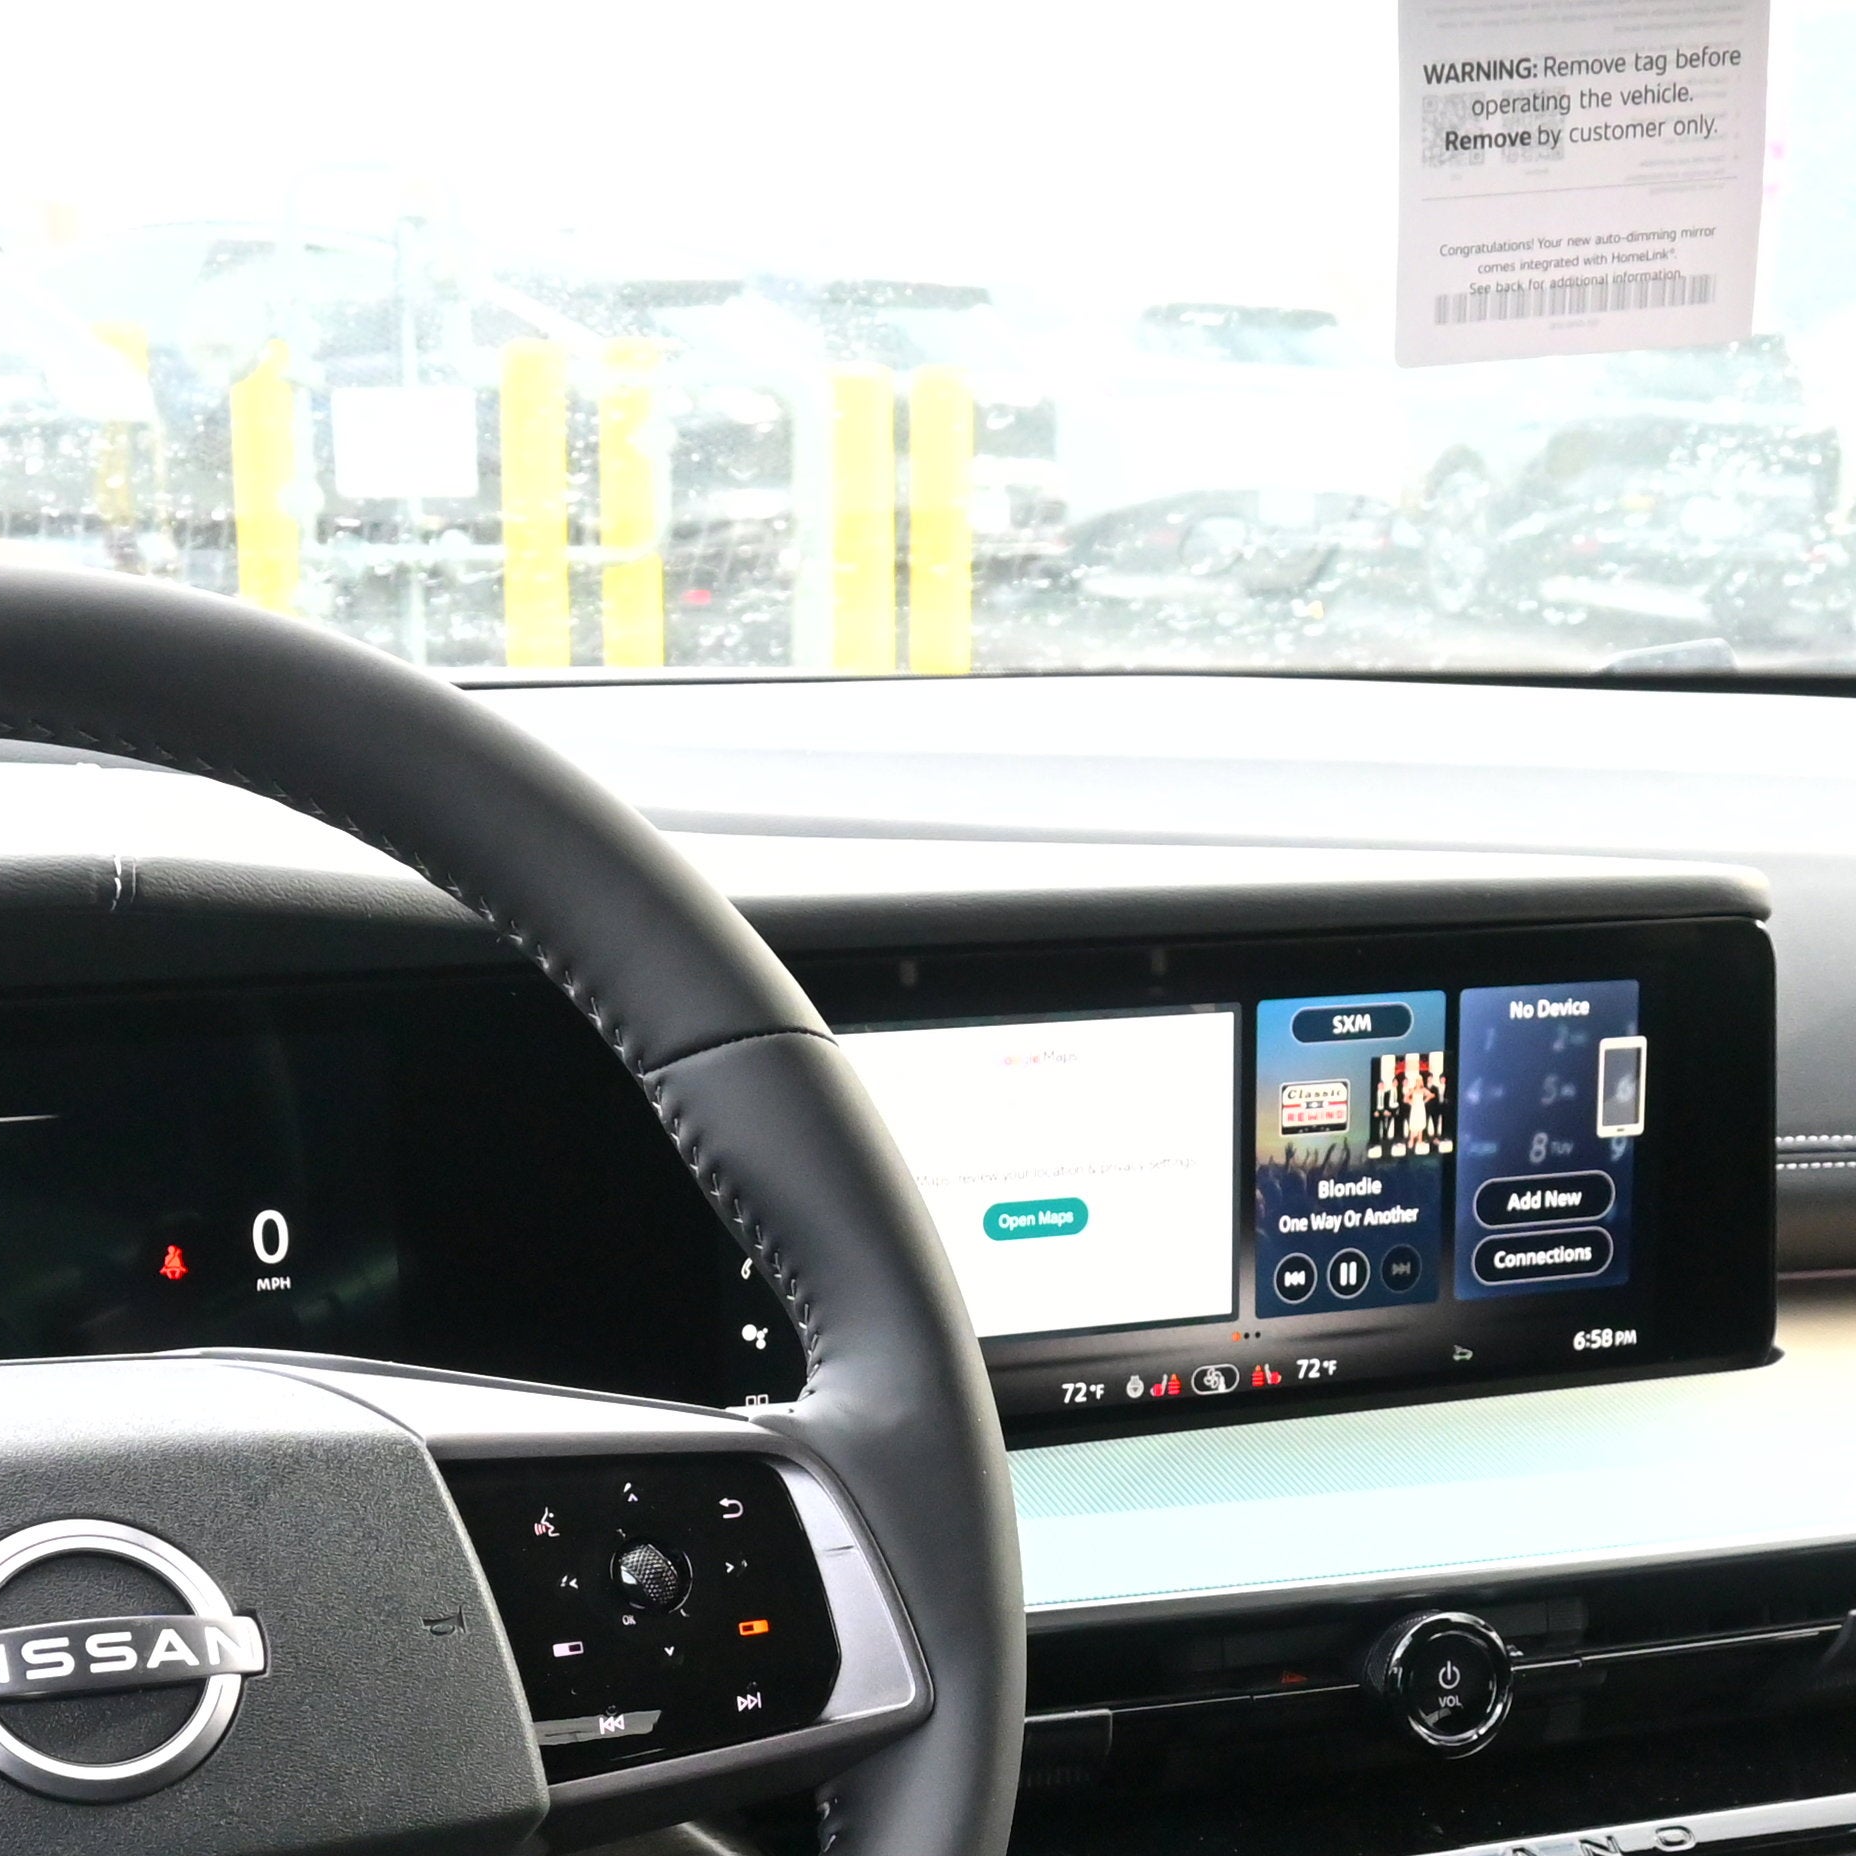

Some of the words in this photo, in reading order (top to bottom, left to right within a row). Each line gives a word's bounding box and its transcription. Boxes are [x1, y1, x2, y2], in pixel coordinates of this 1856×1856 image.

[1423, 56, 1538, 85] WARNING:
[1544, 53, 1626, 78] Remove
[1634, 51, 1667, 76] tag
[1676, 46, 1742, 70] before
[1471, 90, 1571, 120] operating
[1580, 88, 1612, 110] the
[1620, 83, 1693, 107] vehicle.
[1444, 130, 1532, 151] Remove
[1538, 124, 1561, 149] by
[1569, 118, 1665, 144] customer
[1673, 114, 1718, 140] only.
[1439, 238, 1535, 259] Congratulations!
[1538, 234, 1563, 249] Your
[1567, 235, 1591, 247] new
[1594, 227, 1677, 247] auto-dimming
[1681, 225, 1716, 240] mirror
[1477, 262, 1515, 274] comes
[1519, 253, 1580, 273] integrated
[1583, 252, 1608, 267] with
[1469, 282, 1491, 295] See
[1495, 279, 1524, 295] back
[1528, 277, 1545, 291] for
[1549, 271, 1609, 290] additional
[1509, 1001, 1534, 1020] No
[1537, 998, 1590, 1018] Device
[1332, 1015, 1372, 1034] SXM
[1286, 1088, 1343, 1100] Classic
[1318, 1177, 1382, 1199] Blondie
[1507, 1191, 1542, 1211] Add
[1545, 1188, 1582, 1208] New
[998, 1213, 1035, 1231] Open
[1038, 1210, 1074, 1227] Maps
[1279, 1214, 1308, 1232] One
[1310, 1212, 1342, 1232] Way
[1344, 1210, 1361, 1227] Or
[1364, 1206, 1419, 1226] Another
[252, 1210, 290, 1264] 0
[1493, 1244, 1592, 1269] Connections
[256, 1275, 291, 1292] MPH
[1573, 1329, 1612, 1350] 6:58
[1615, 1328, 1637, 1346] PM
[1438, 1694, 1462, 1708] VOL
